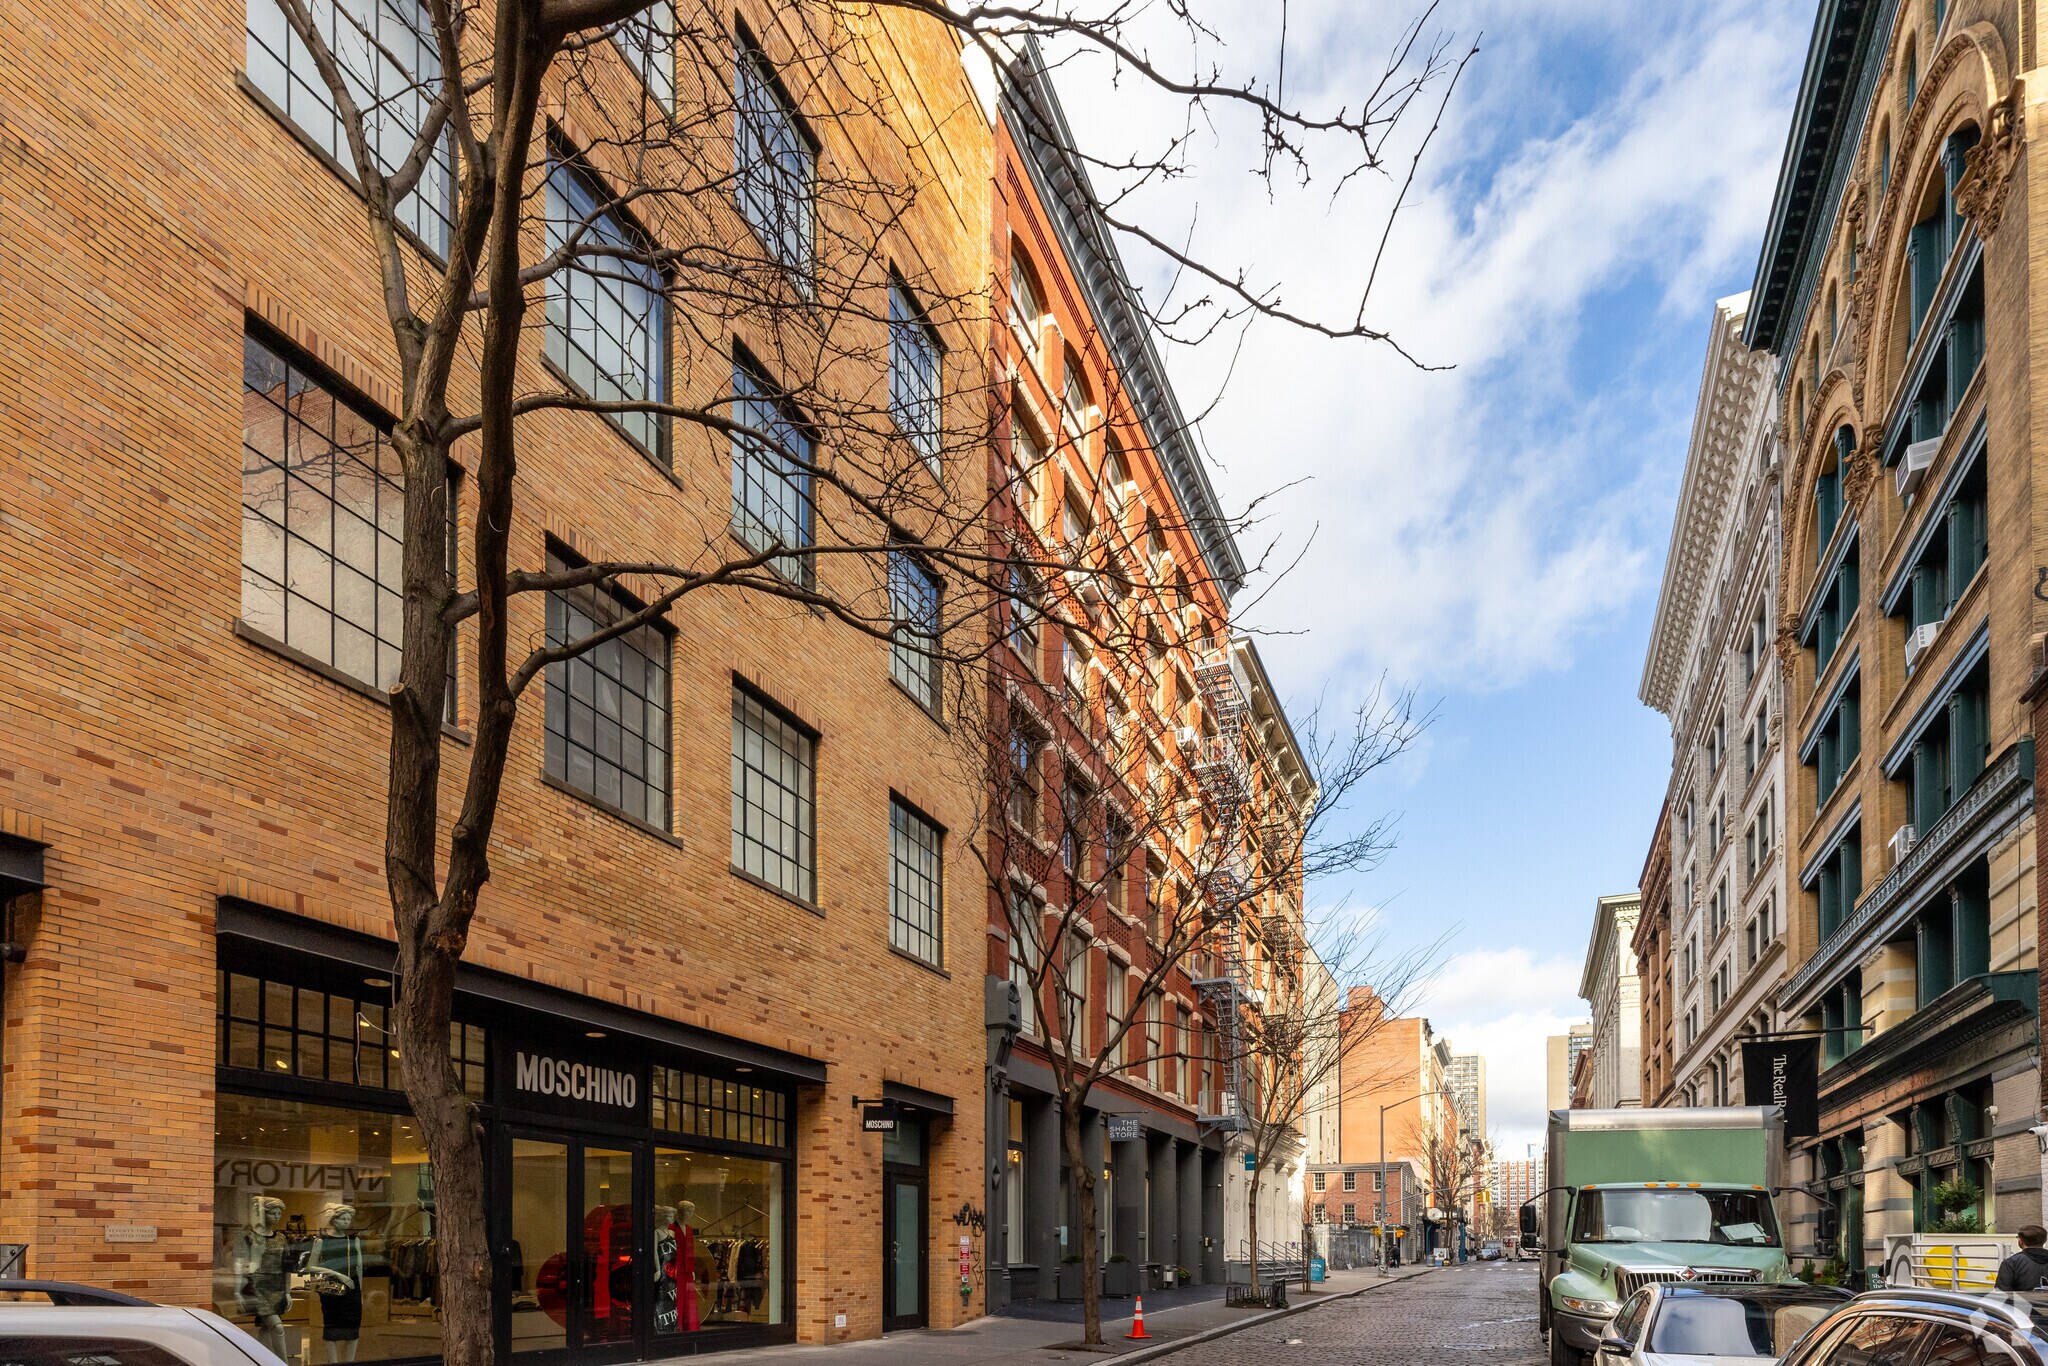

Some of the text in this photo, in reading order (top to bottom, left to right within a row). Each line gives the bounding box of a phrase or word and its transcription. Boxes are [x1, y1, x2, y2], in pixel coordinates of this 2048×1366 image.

[517, 1051, 636, 1108] MOSCHINO
[865, 1119, 894, 1129] MOSCHINO
[1109, 1131, 1138, 1139] STORE
